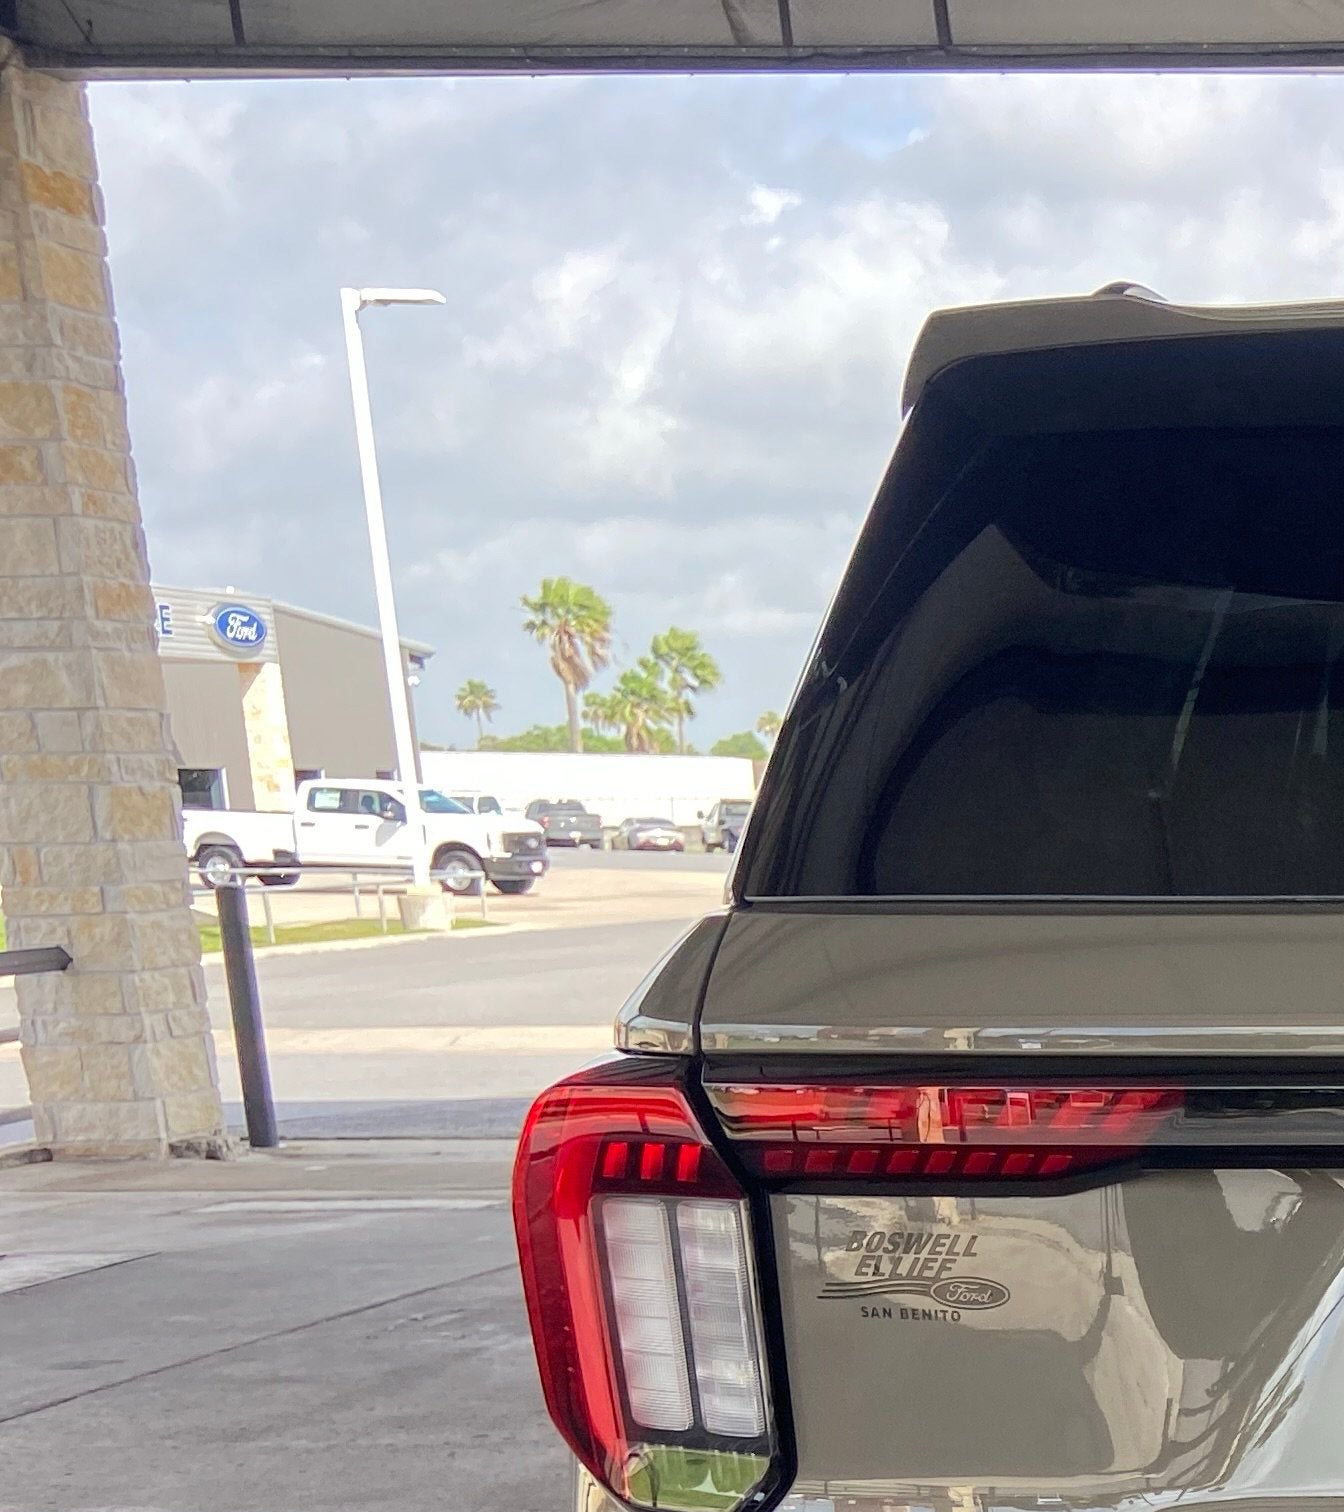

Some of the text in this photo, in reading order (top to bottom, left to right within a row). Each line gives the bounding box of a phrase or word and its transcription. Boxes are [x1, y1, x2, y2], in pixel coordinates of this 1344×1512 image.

[226, 612, 258, 640] Ford
[845, 1230, 979, 1257] BOSWELL
[854, 1254, 957, 1279] ELLIFF
[946, 1282, 993, 1303] Ford
[860, 1305, 962, 1322] SAN BENITO
